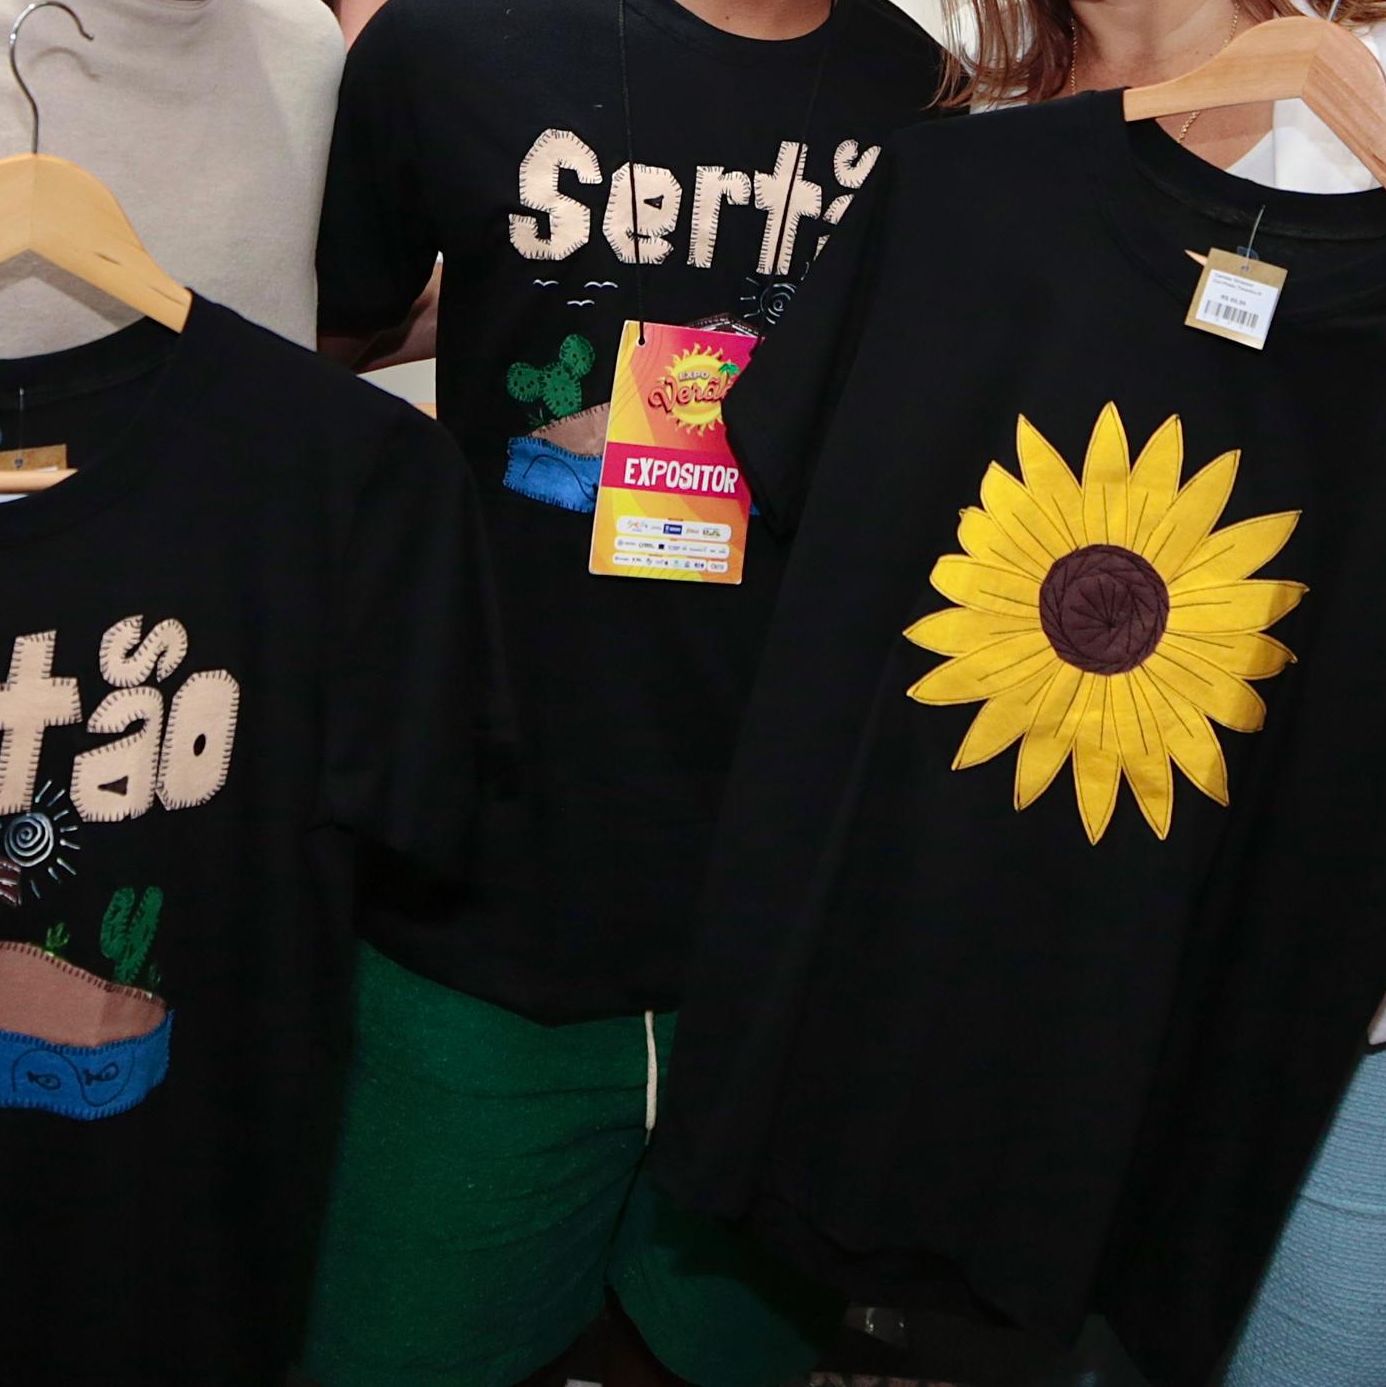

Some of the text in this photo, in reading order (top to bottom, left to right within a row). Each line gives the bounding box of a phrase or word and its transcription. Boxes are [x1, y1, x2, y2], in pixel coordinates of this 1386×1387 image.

[508, 128, 882, 276] Sert
[679, 370, 710, 382] EXPO
[624, 457, 740, 494] EXPOSITOR
